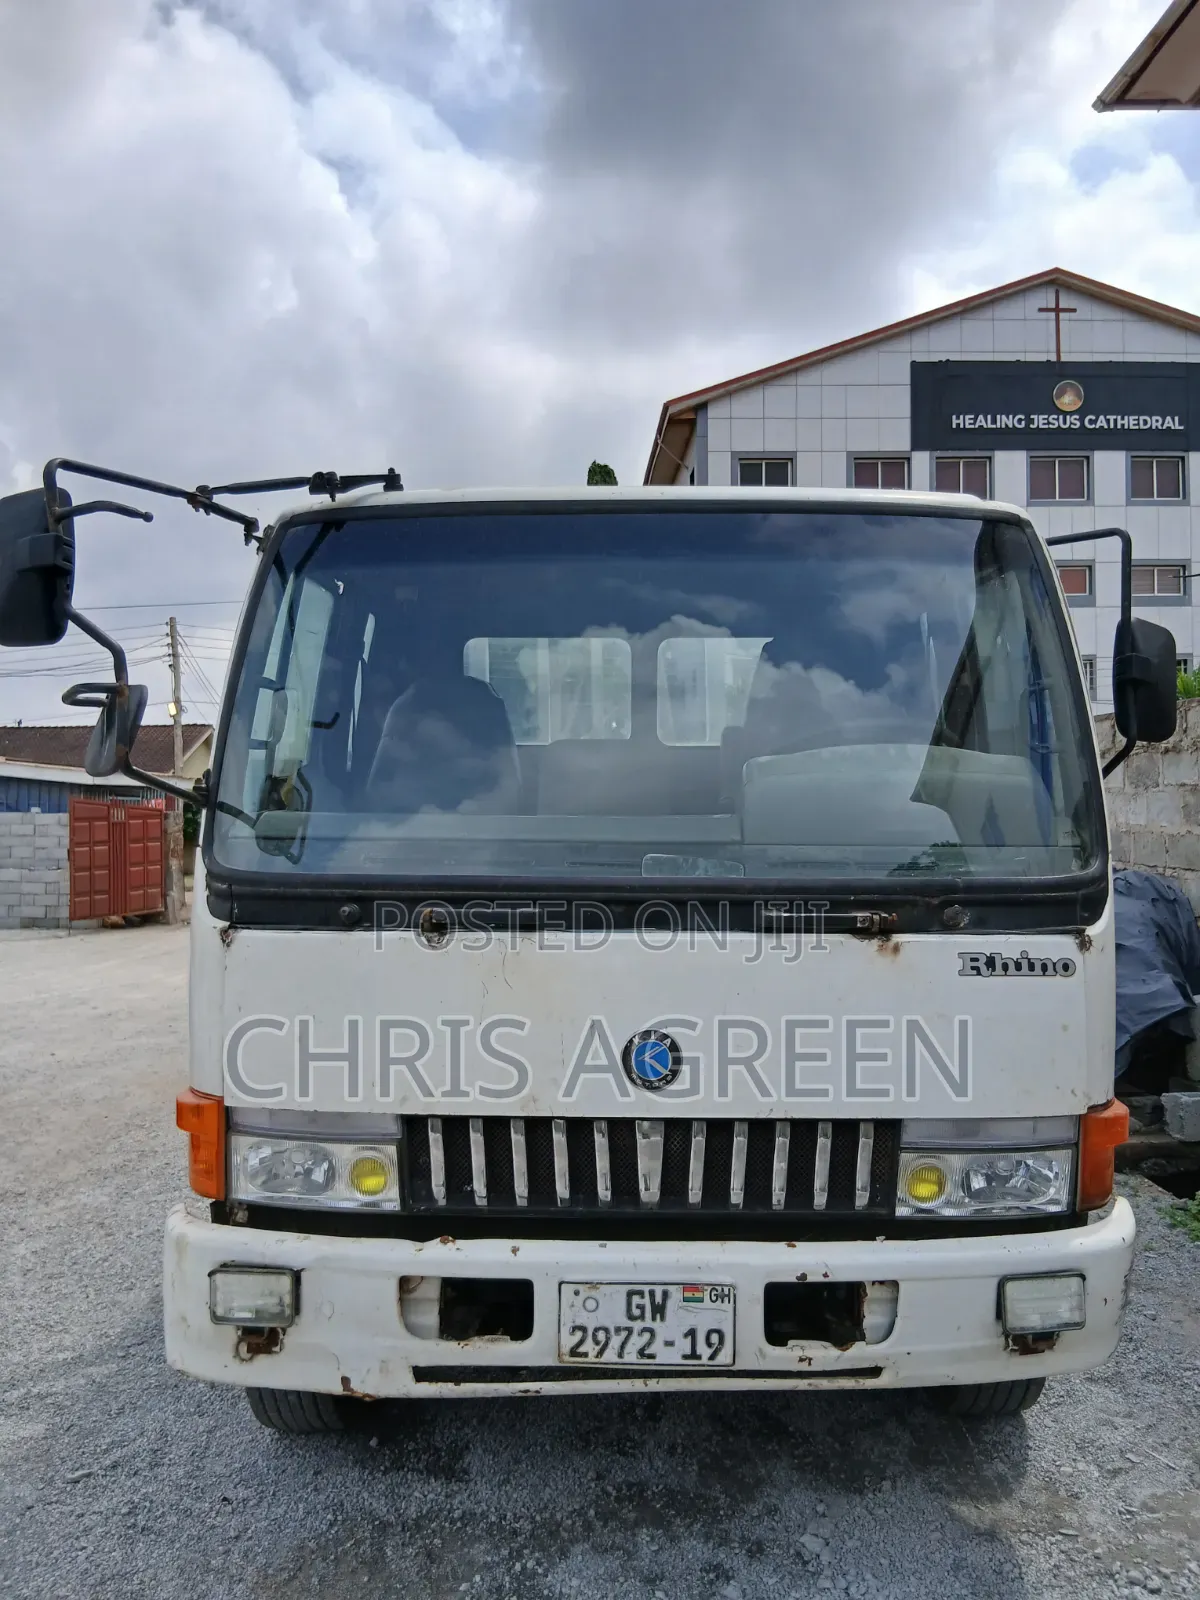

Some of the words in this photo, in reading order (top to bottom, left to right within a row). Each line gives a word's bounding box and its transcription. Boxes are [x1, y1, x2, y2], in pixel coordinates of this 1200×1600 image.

[951, 414, 1026, 429] HEALING
[1029, 415, 1081, 429] JESUS
[1084, 415, 1185, 430] CATHEDRAL
[957, 949, 1077, 978] Rhino
[632, 1030, 672, 1048] KIA
[625, 1288, 670, 1323] GW
[709, 1286, 731, 1304] GH
[568, 1324, 726, 1362] 2972-19
